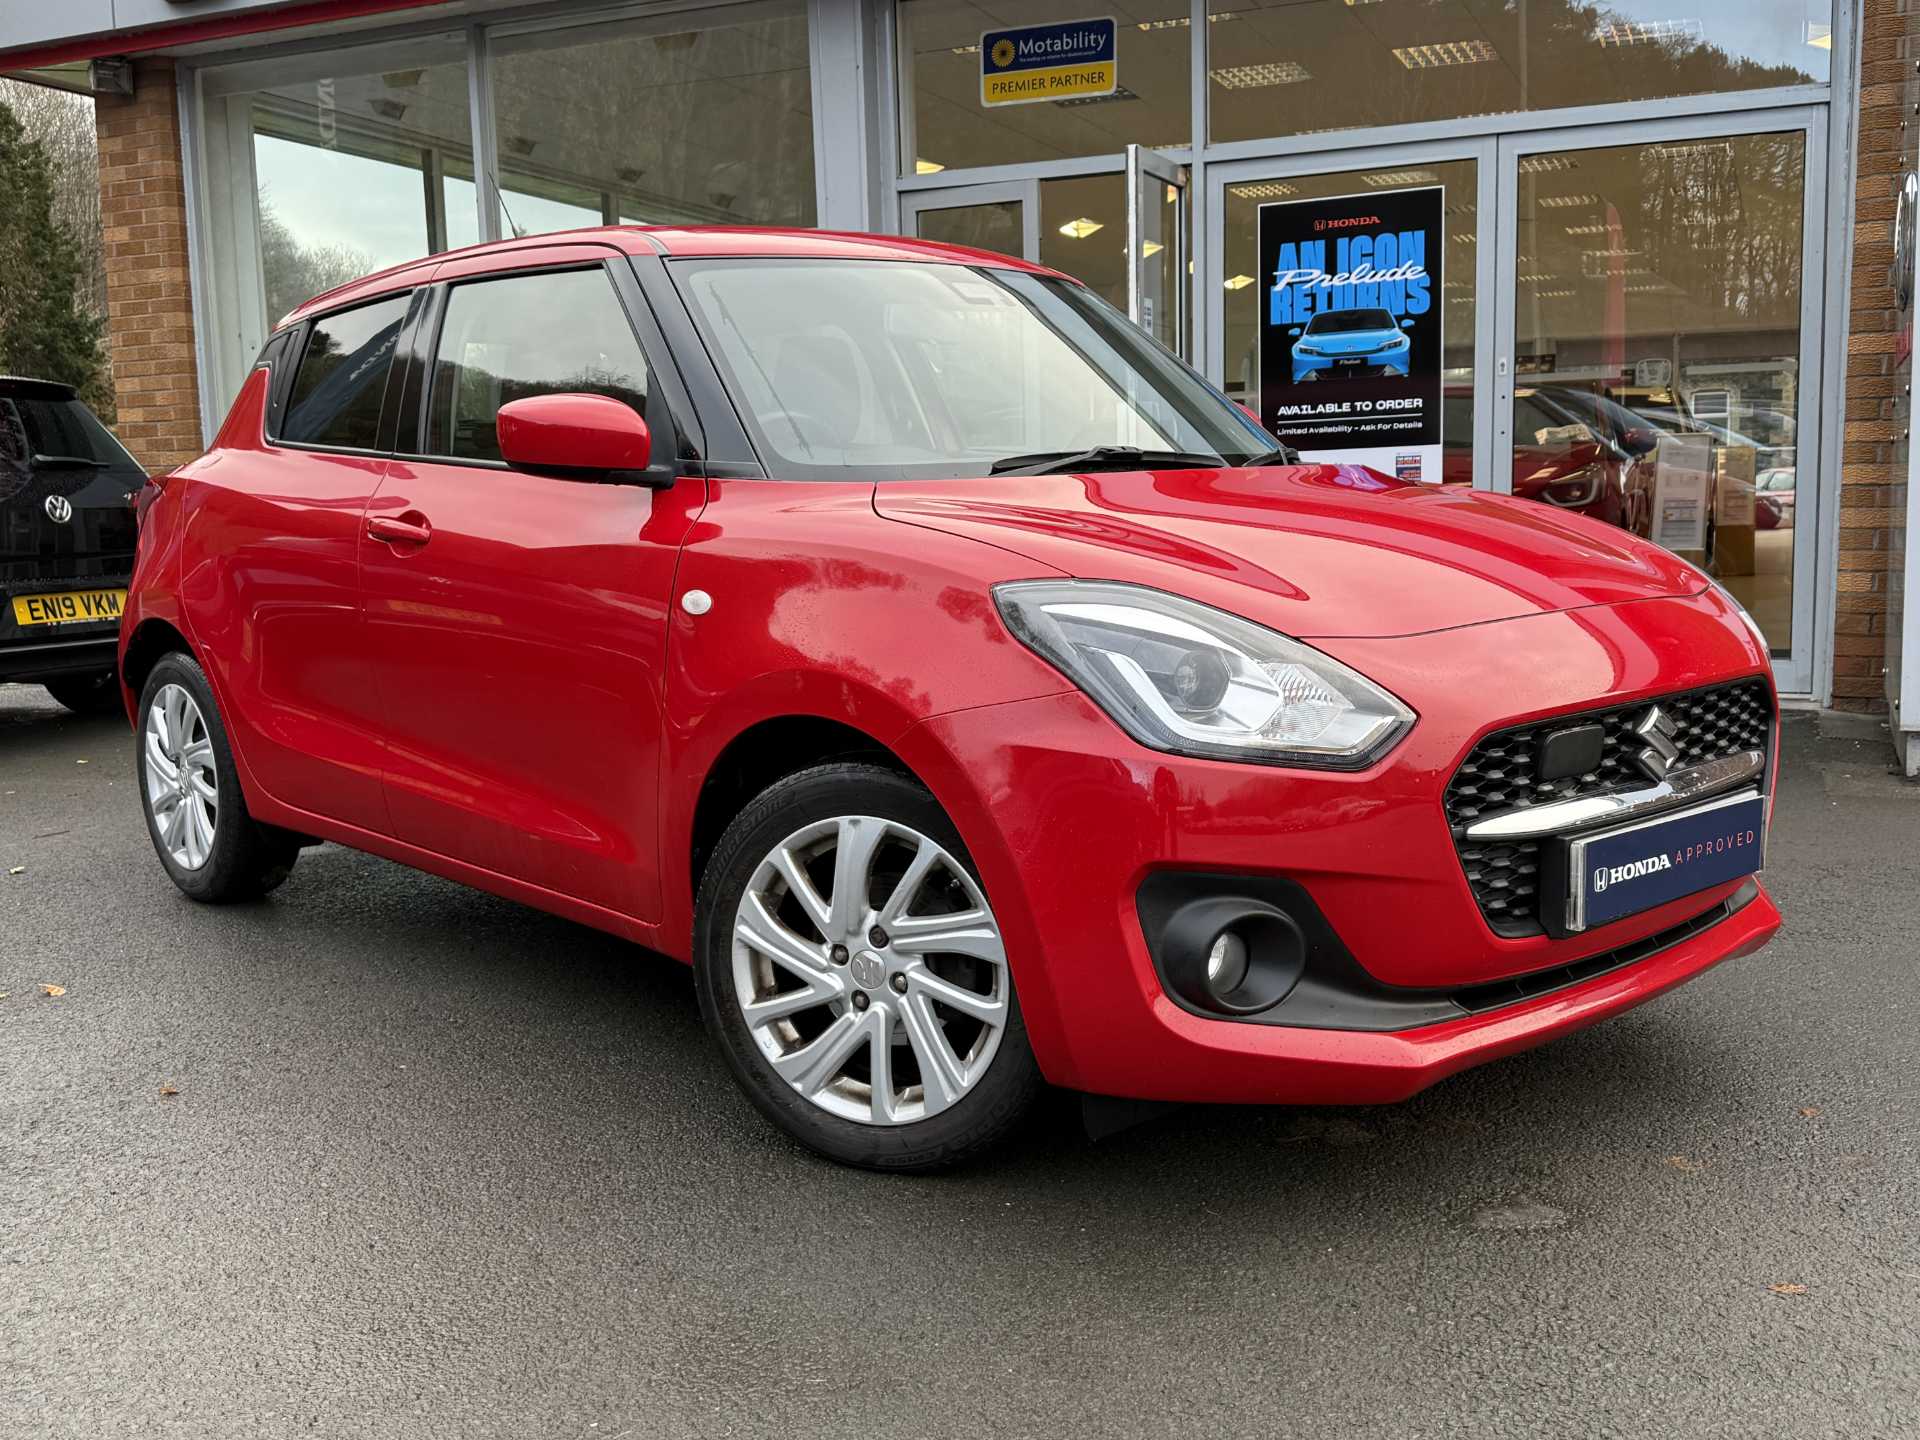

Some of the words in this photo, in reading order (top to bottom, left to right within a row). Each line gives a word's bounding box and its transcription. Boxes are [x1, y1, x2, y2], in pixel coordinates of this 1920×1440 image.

[1018, 32, 1107, 56] Motability
[992, 78, 1047, 95] PREMIER
[1050, 71, 1105, 88] PARTNER
[1327, 216, 1381, 229] HONDA
[1275, 239, 1326, 284] AN
[1337, 230, 1425, 275] ICON
[1272, 259, 1427, 291] Prelude
[1277, 403, 1351, 416] AVAILABLE
[1354, 401, 1372, 412] TO
[1376, 398, 1423, 411] ORDER
[1277, 426, 1307, 436] Limited
[1309, 424, 1353, 435] Availability
[1360, 424, 1376, 432] Ask
[1377, 422, 1392, 431] For
[1393, 421, 1423, 430] Details
[27, 596, 77, 621] EN19
[80, 592, 121, 616] VKM
[1609, 853, 1672, 885] HONDA
[1674, 830, 1755, 865] APPROVED
